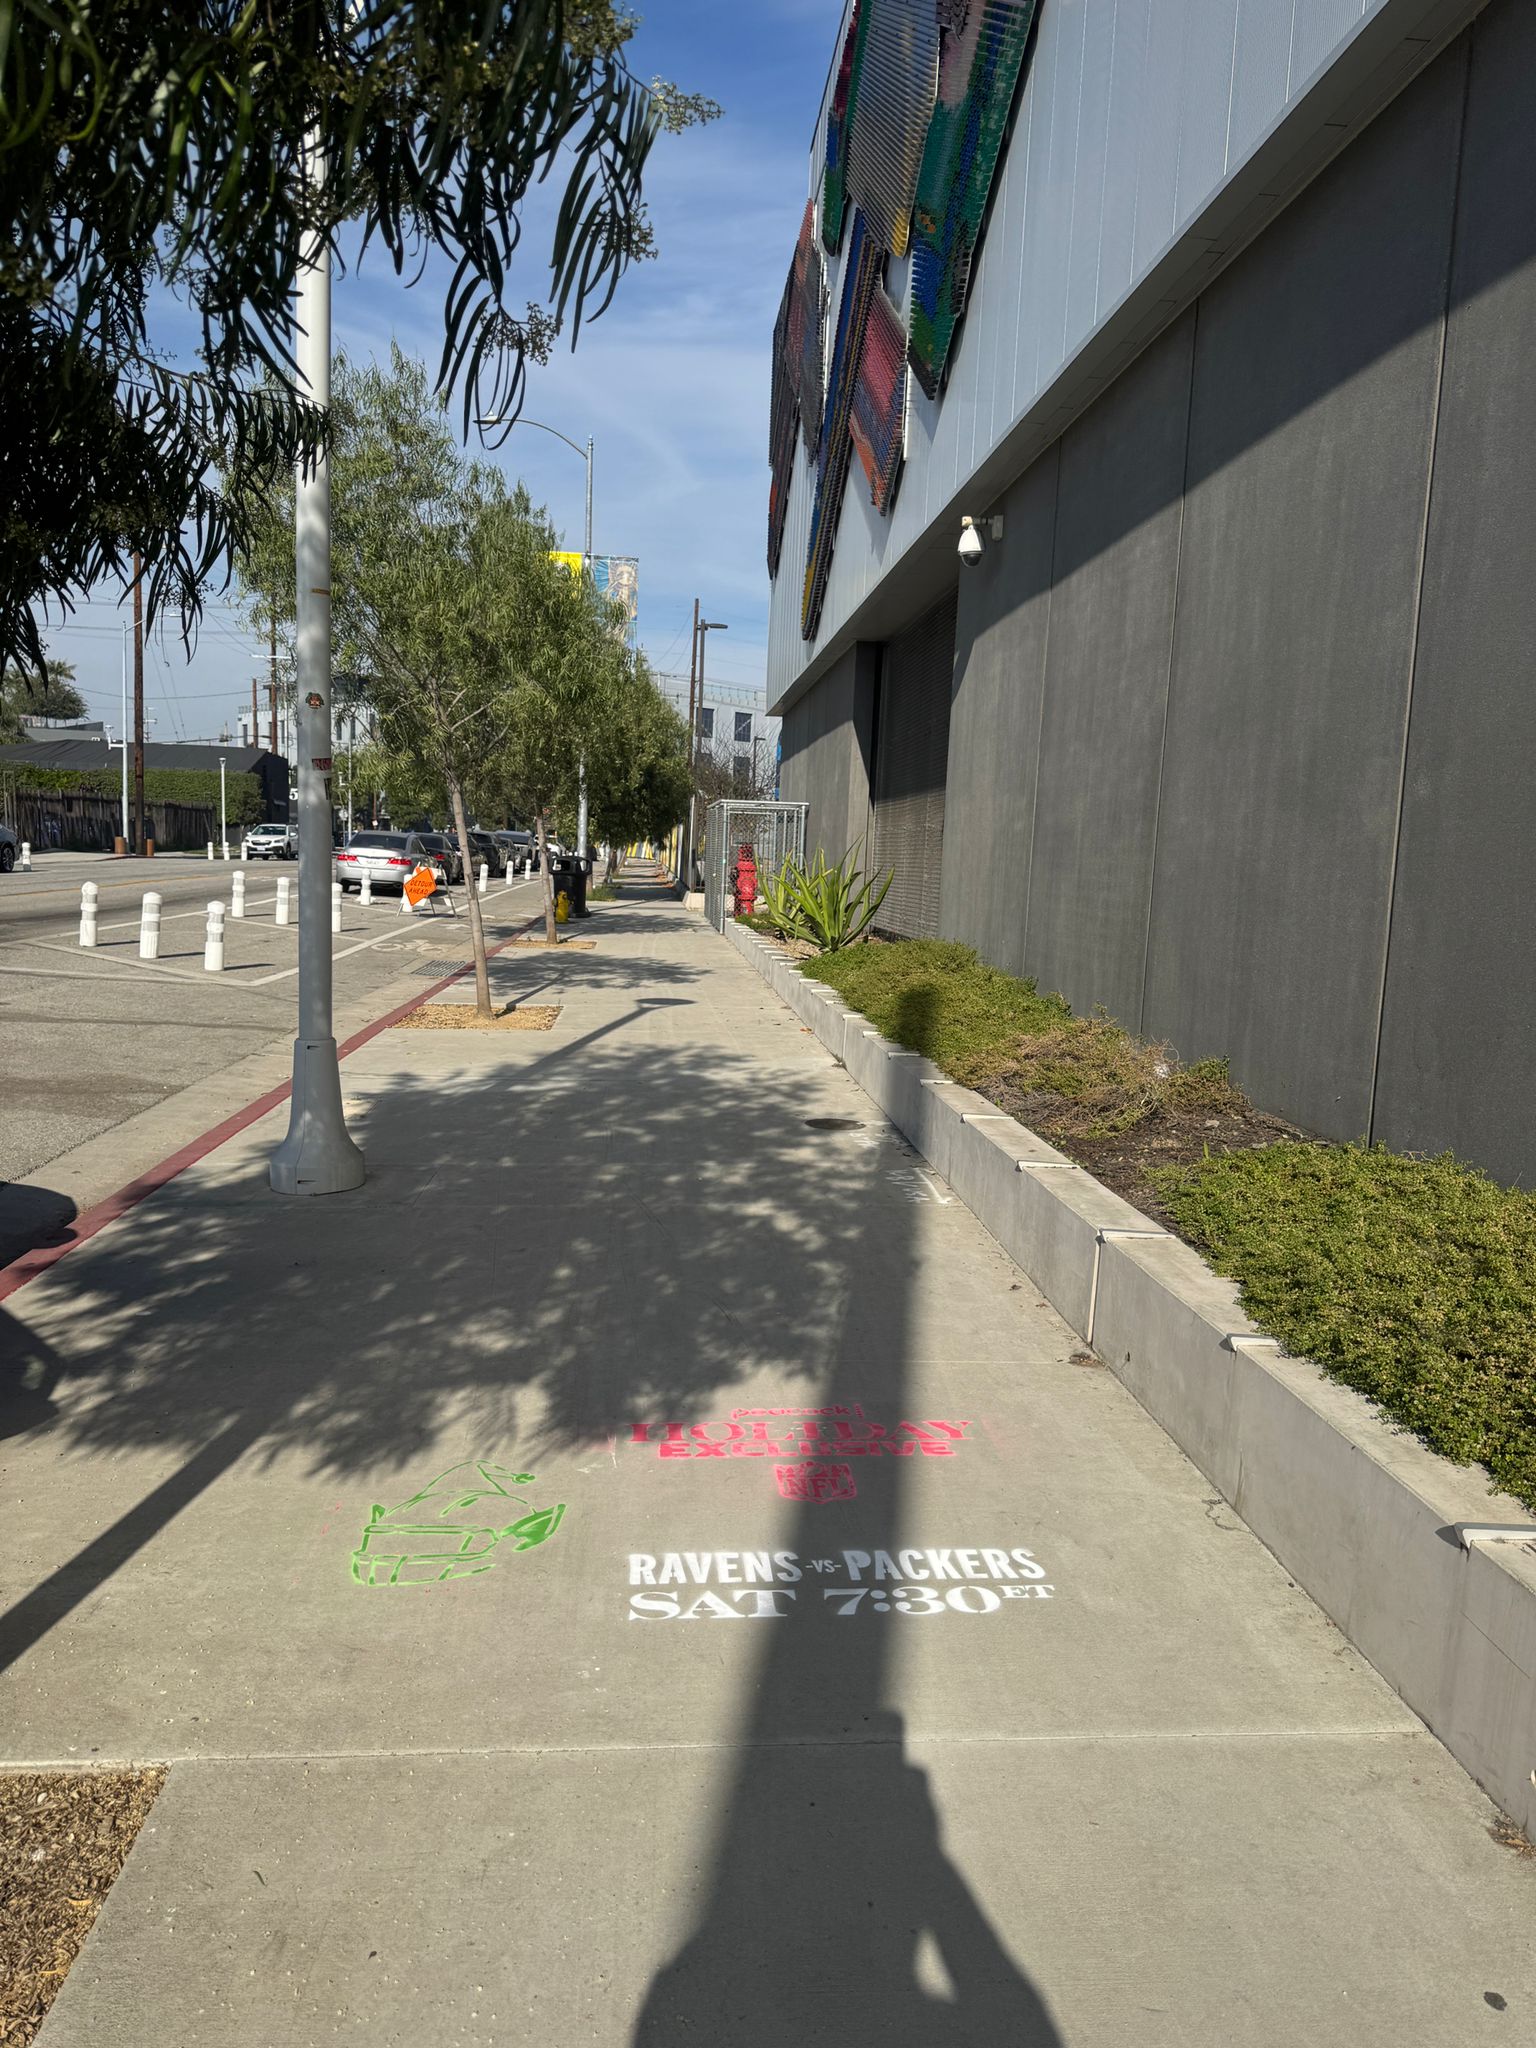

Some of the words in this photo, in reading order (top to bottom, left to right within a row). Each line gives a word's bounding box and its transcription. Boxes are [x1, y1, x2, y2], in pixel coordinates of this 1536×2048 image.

[731, 1405, 850, 1421] peacock
[629, 1420, 974, 1442] HOLIDAY
[657, 1440, 956, 1459] EXCLUSIVE
[786, 1477, 850, 1498] NFL
[629, 1551, 803, 1585] RAVENS
[842, 1548, 1046, 1582] PACKERS
[628, 1588, 797, 1621] SAT
[824, 1585, 1002, 1617] 7:30
[1002, 1583, 1056, 1599] ET
